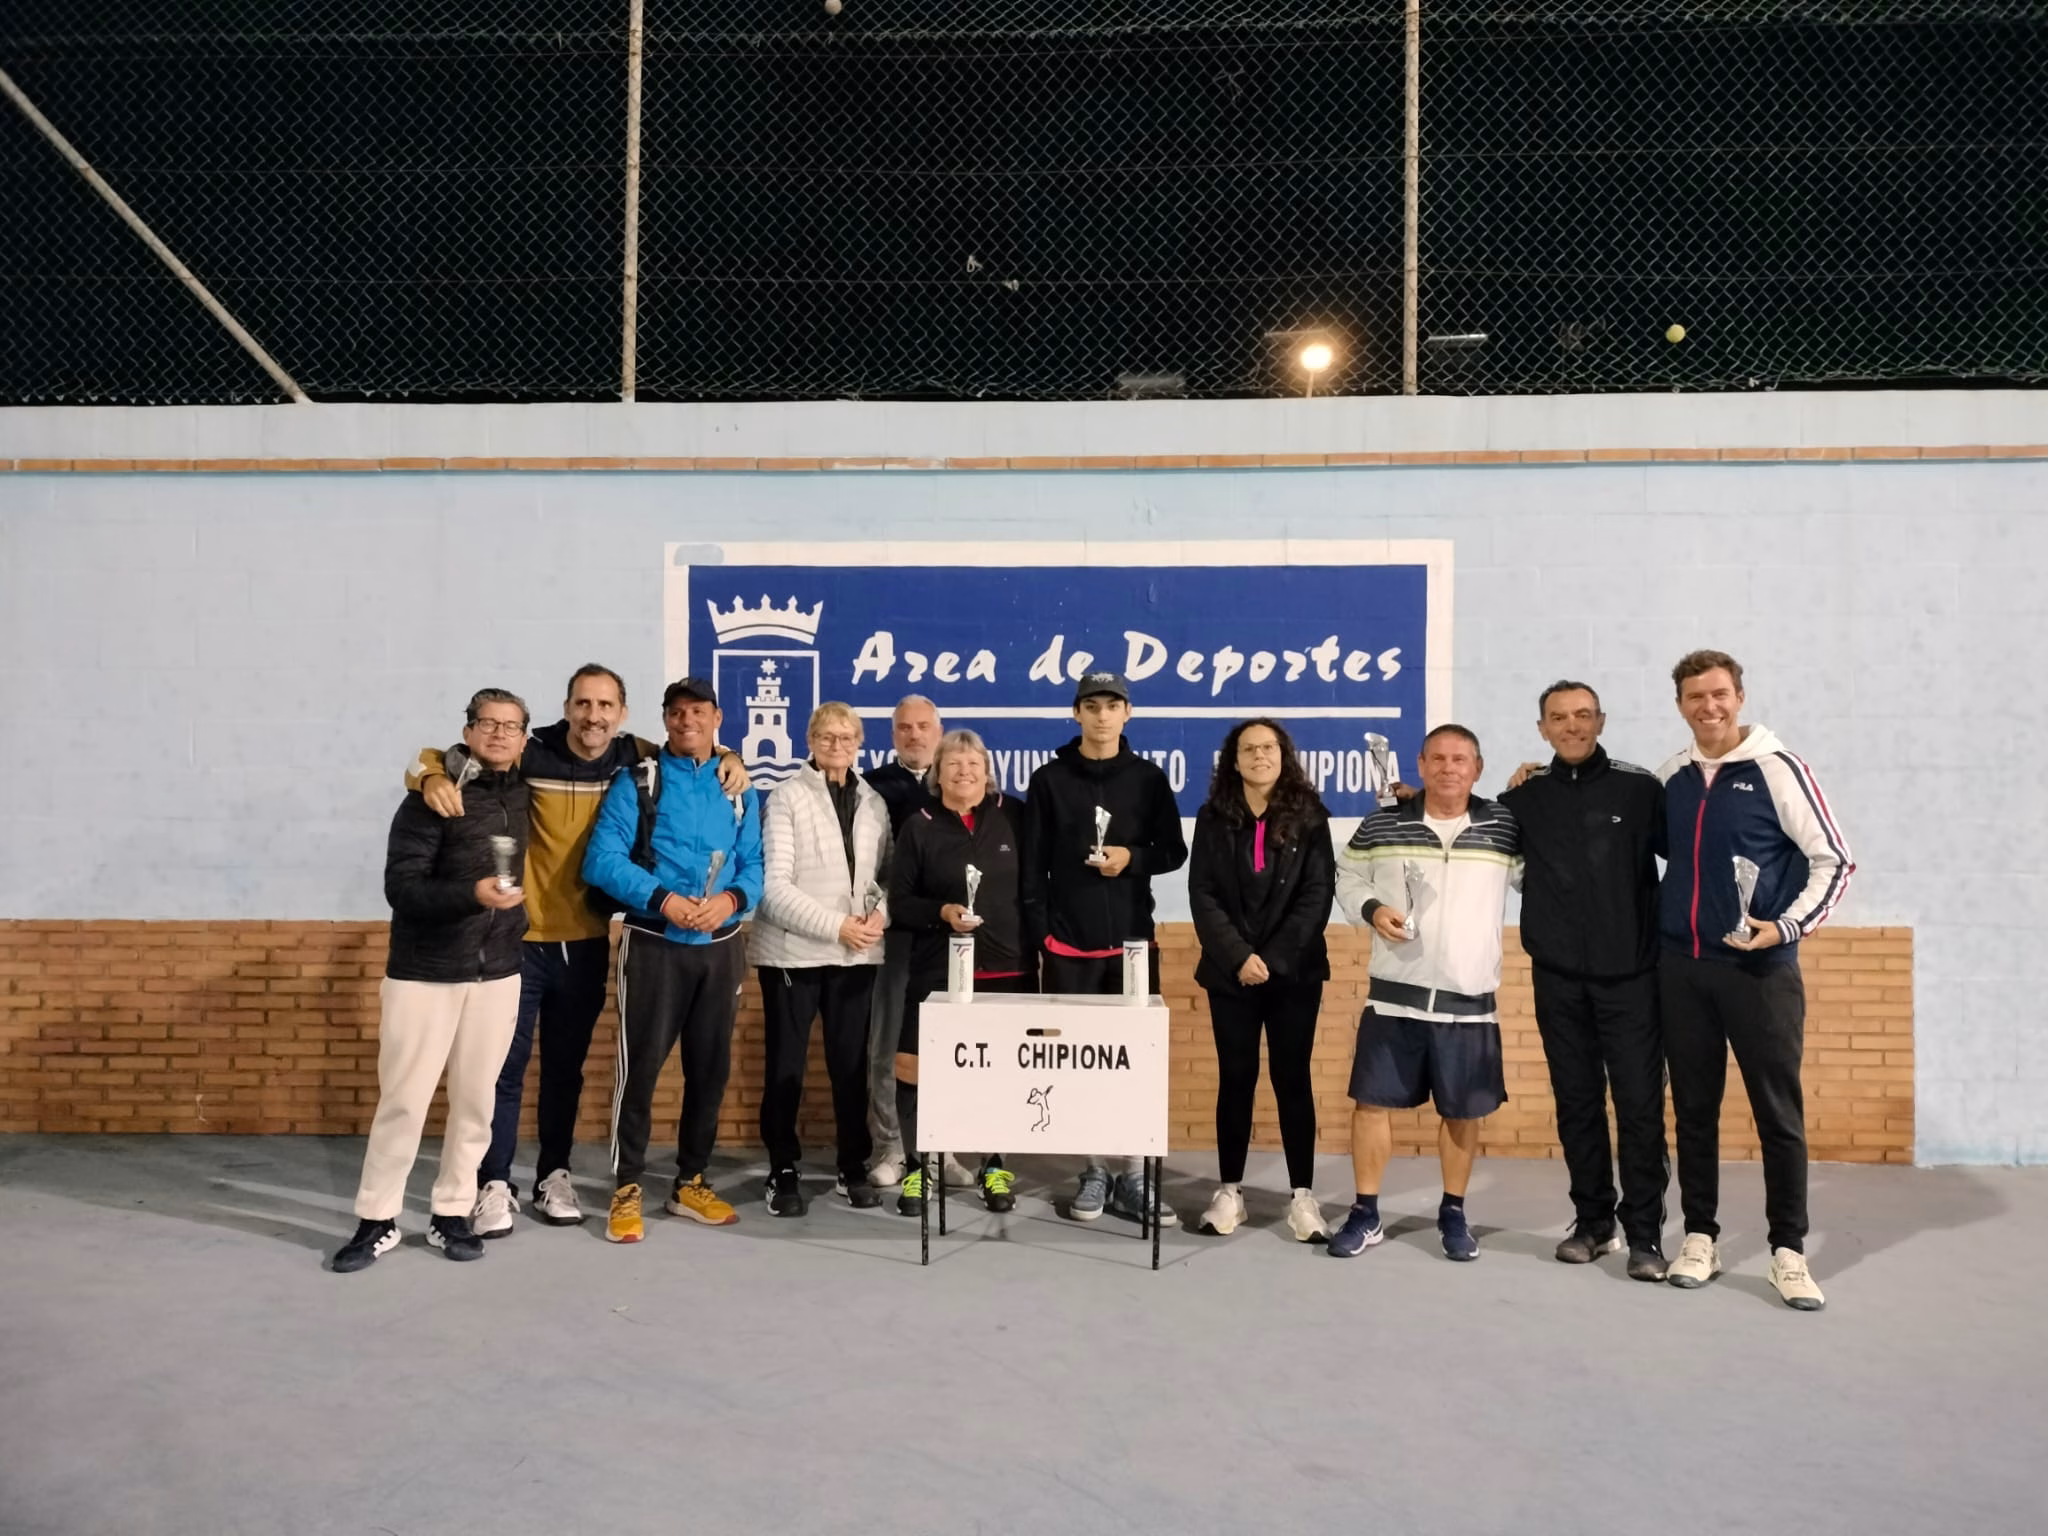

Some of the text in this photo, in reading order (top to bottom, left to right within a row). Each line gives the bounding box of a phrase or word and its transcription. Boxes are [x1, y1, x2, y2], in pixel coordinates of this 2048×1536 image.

[851, 630, 1401, 697] Area de Deportes
[1294, 750, 1401, 793] IPIONA
[954, 1042, 1131, 1070] C.T. CHIPIONA
